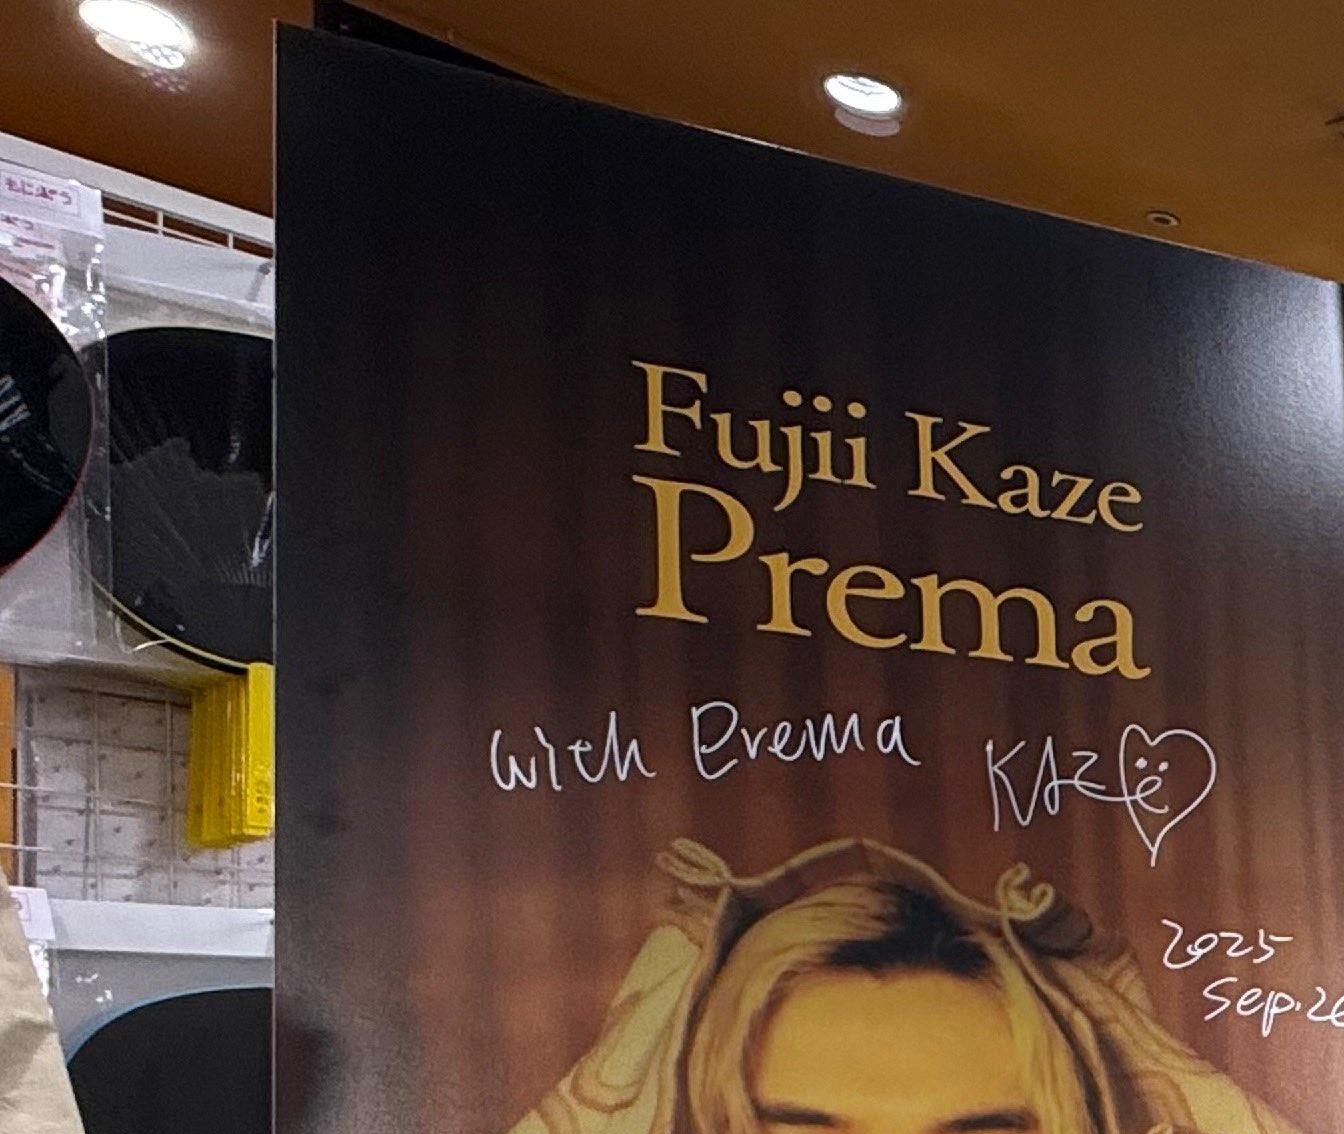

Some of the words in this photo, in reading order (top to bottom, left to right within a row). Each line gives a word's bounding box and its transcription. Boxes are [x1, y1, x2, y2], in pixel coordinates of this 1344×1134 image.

[631, 360, 877, 512] Fujii
[904, 410, 1144, 533] Kaze
[631, 473, 1153, 681] Prema
[691, 700, 922, 780] Prema
[1160, 918, 1294, 970] 2025
